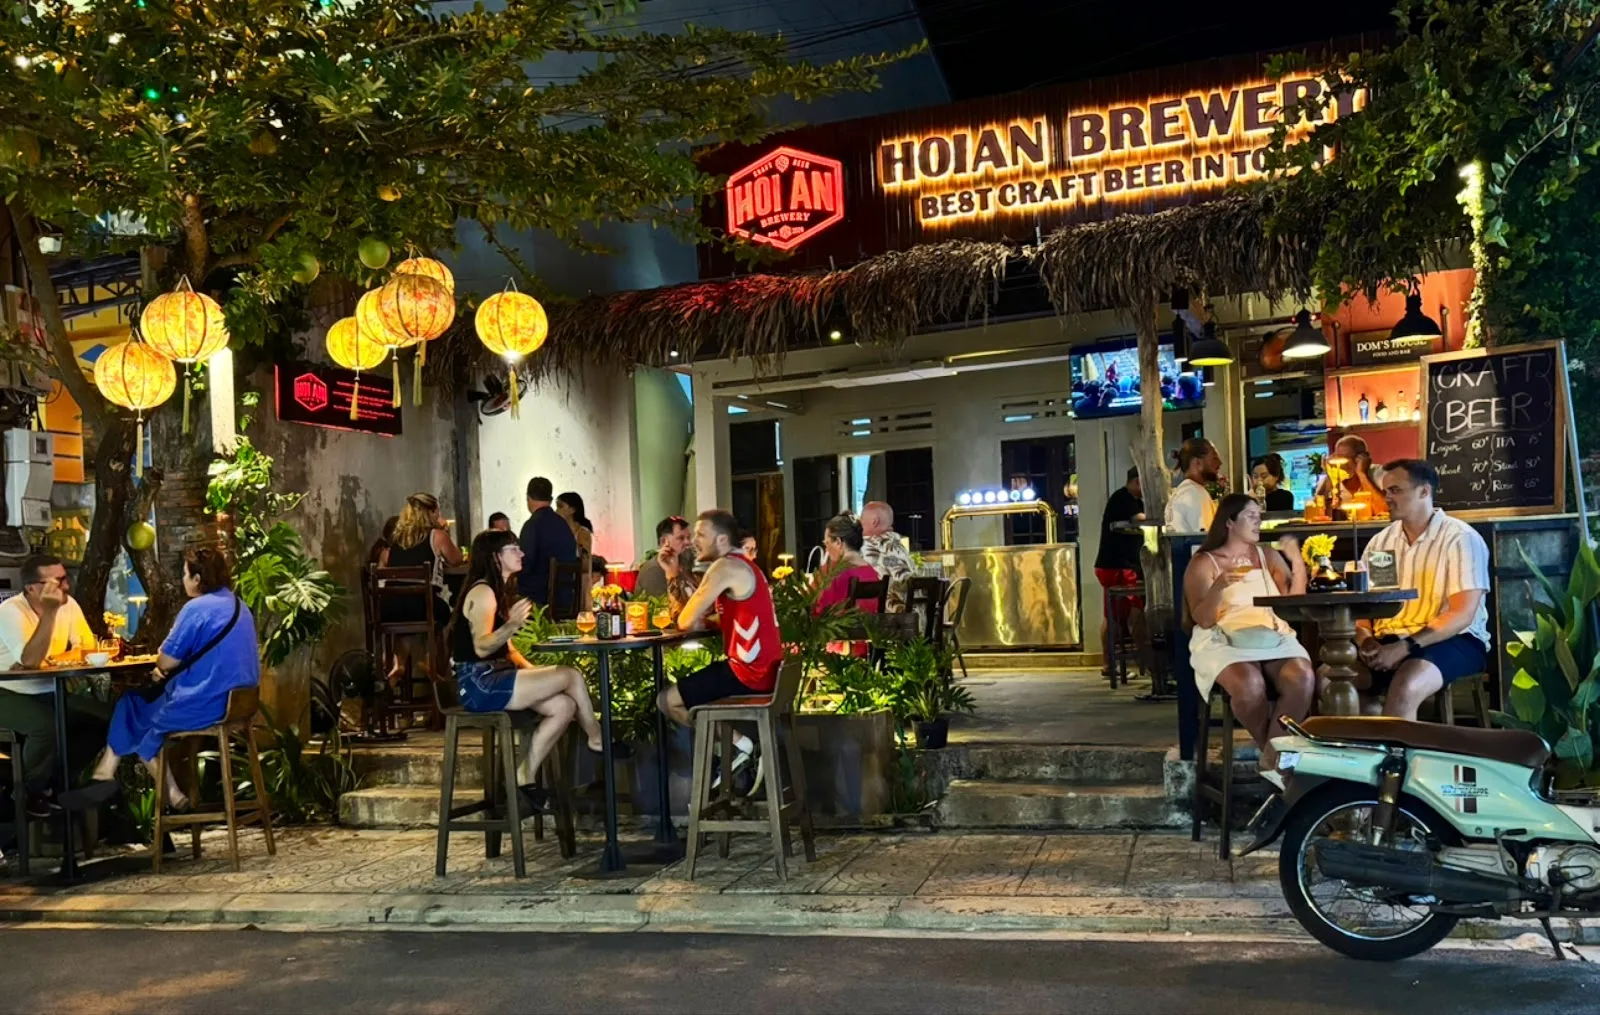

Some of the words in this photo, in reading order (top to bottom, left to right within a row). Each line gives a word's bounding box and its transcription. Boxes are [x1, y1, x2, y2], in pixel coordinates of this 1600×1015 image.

[881, 121, 1044, 184] HOIAN
[735, 174, 782, 226] HOI
[790, 171, 834, 212] AN
[921, 188, 992, 219] BEST
[998, 172, 1096, 207] CRAFT
[1104, 159, 1186, 193] BEER
[1192, 152, 1225, 181] IN
[1232, 141, 1324, 176] TO
[760, 212, 810, 228] BREWERY
[1356, 340, 1390, 352] DOM'S
[1437, 353, 1545, 388] CRAFT
[1446, 392, 1532, 433] BEER
